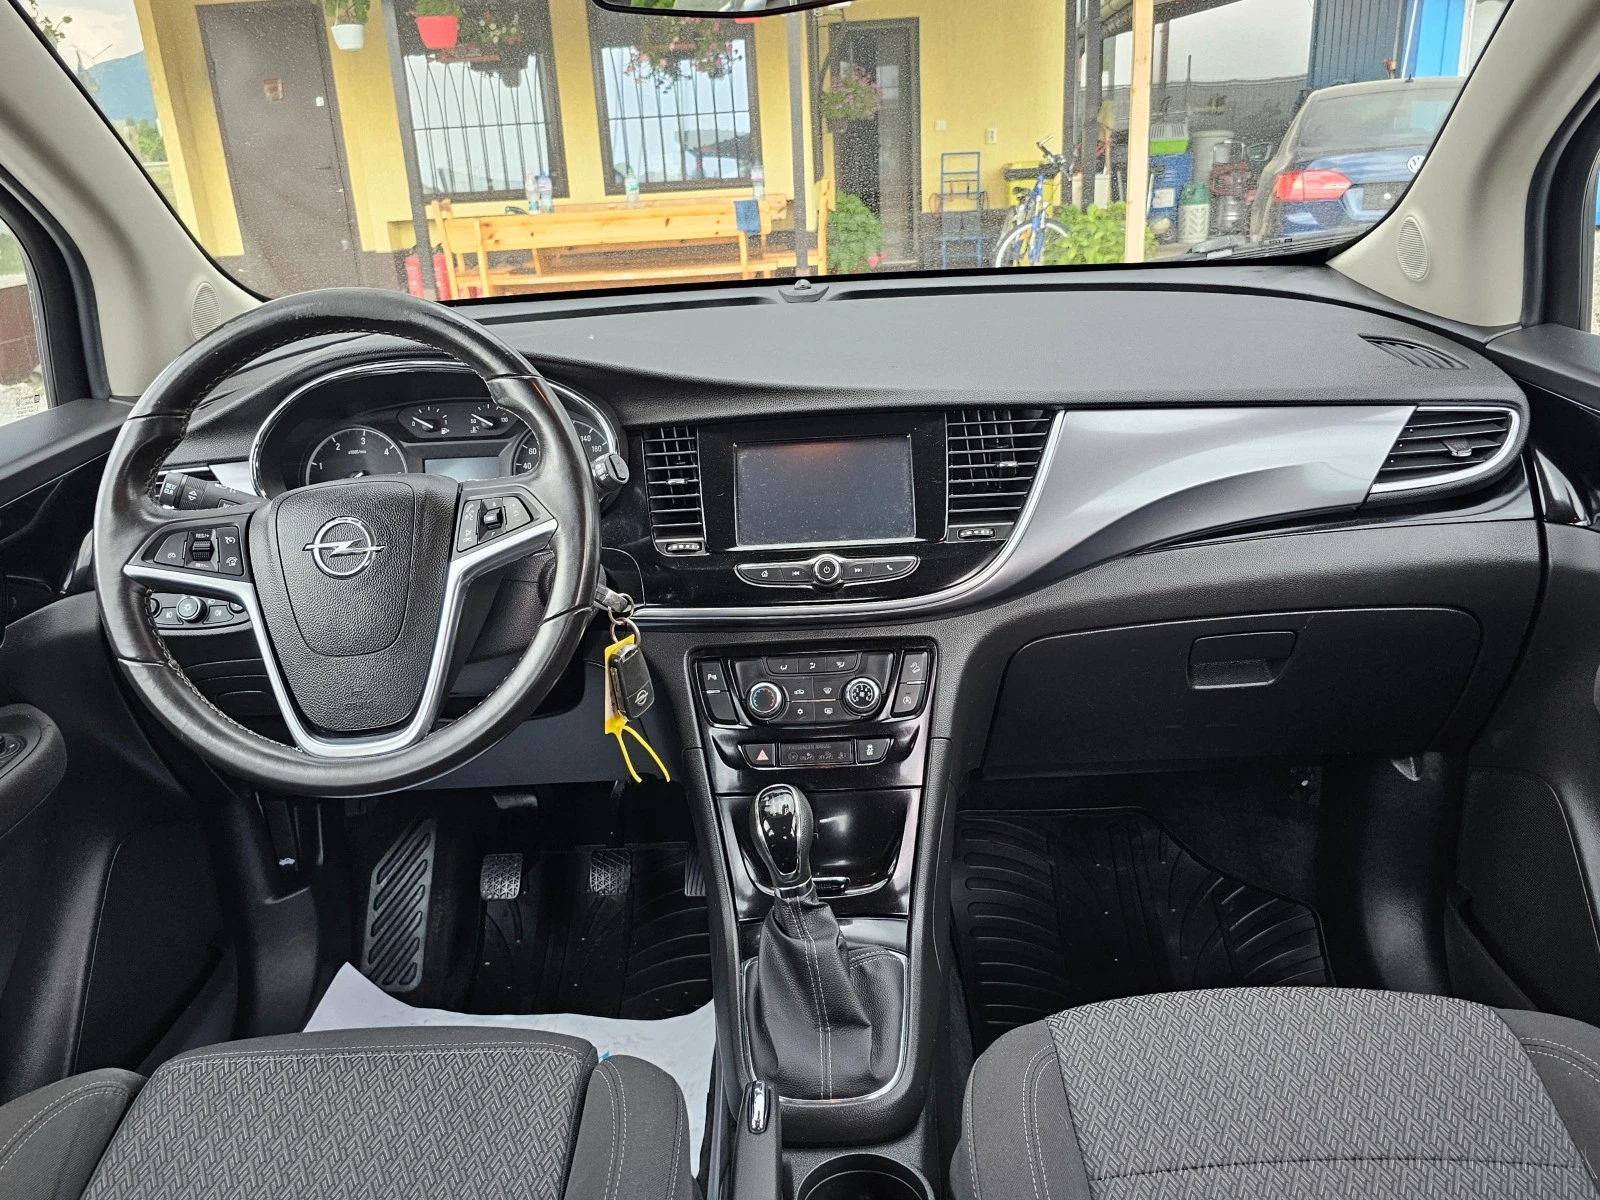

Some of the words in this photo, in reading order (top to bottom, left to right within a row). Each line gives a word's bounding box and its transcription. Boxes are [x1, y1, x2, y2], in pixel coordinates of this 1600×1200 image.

[360, 437, 366, 445] 3
[335, 443, 341, 451] 2
[591, 445, 602, 453] 160
[523, 462, 532, 470] 40
